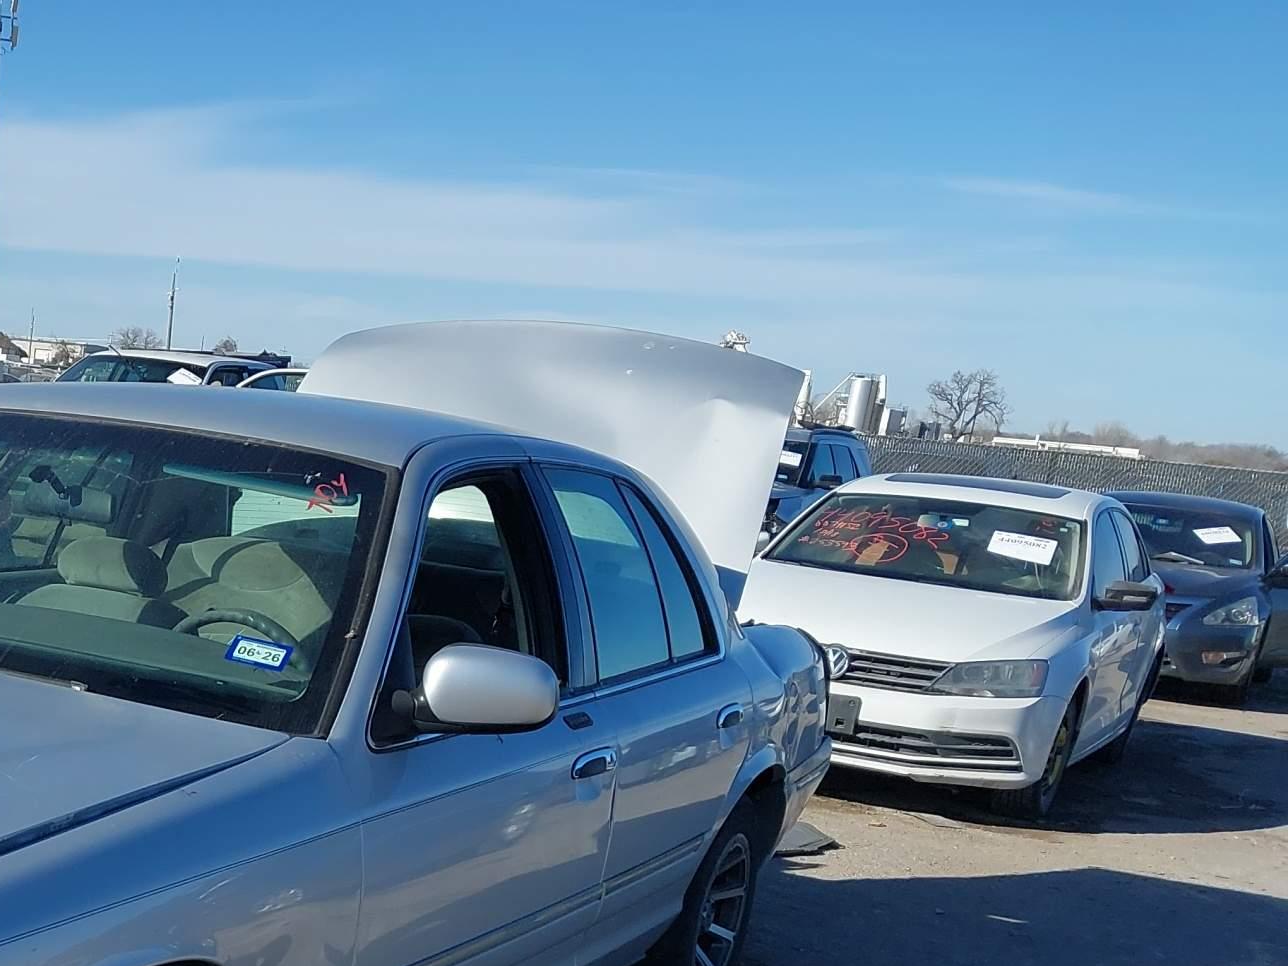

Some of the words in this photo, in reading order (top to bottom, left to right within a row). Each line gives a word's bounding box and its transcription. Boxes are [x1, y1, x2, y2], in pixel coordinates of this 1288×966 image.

[998, 537, 1048, 550] 44095082
[237, 645, 256, 657] 06
[261, 651, 281, 663] 26
